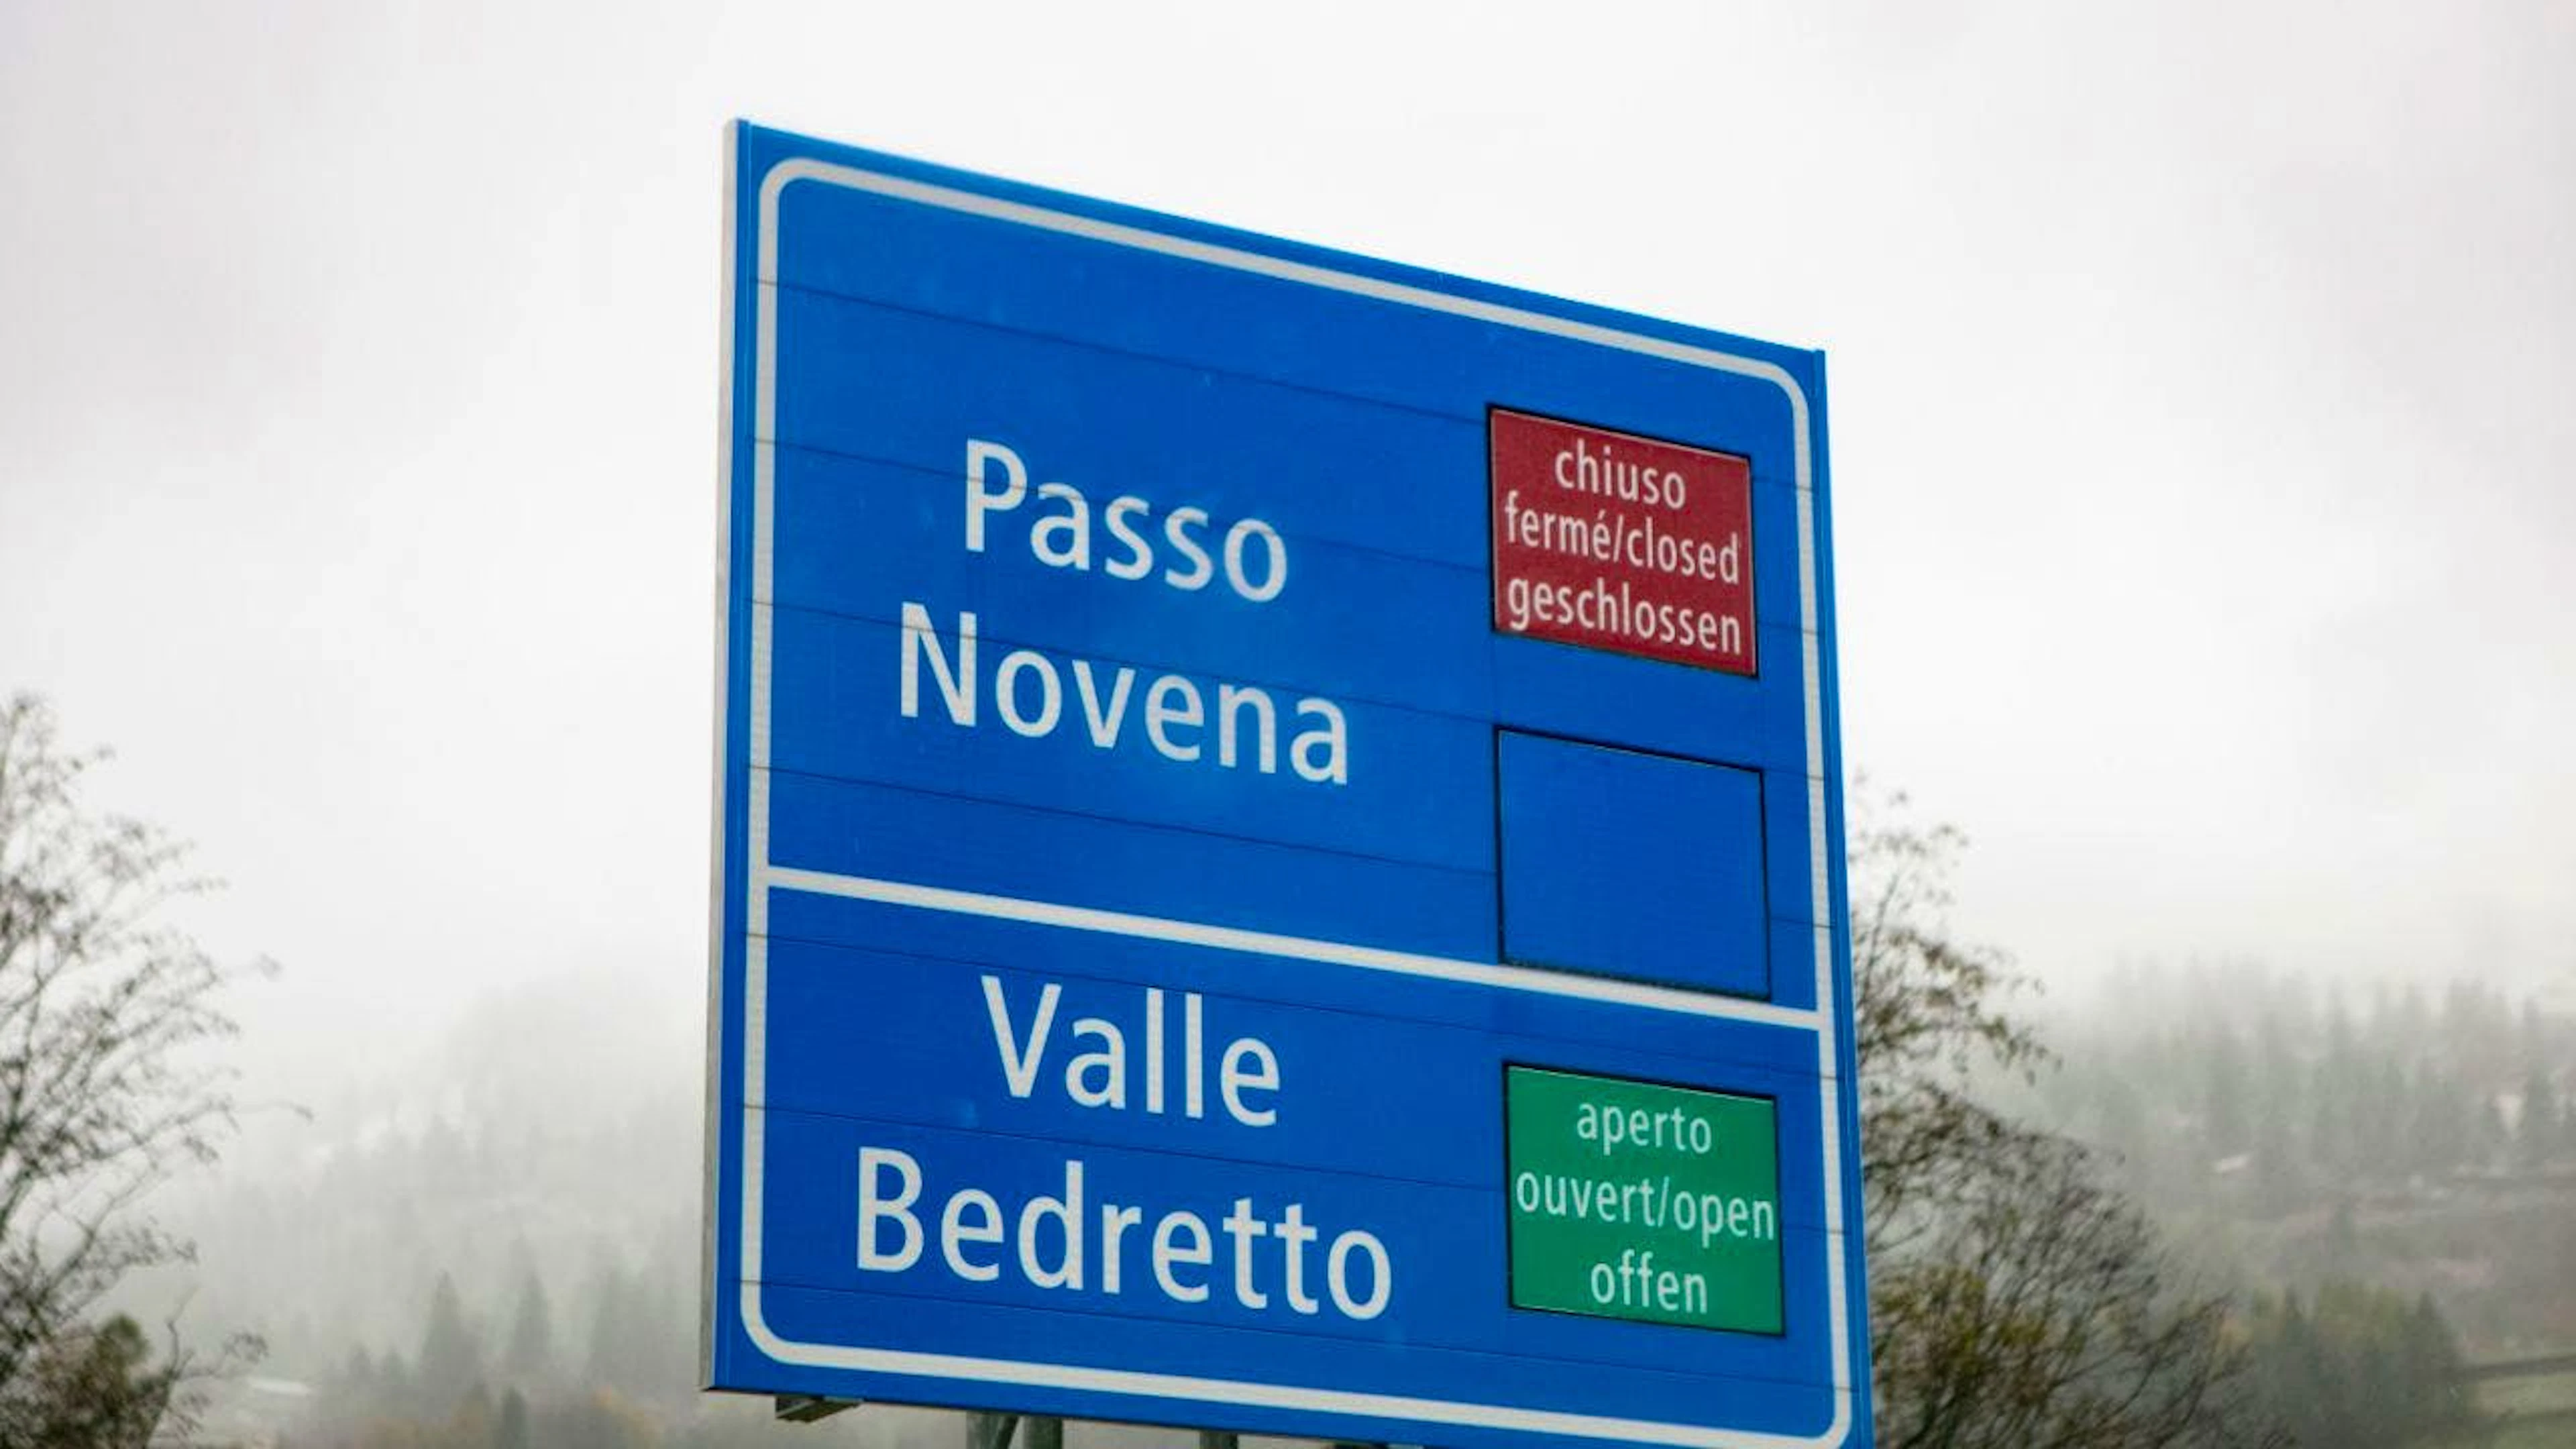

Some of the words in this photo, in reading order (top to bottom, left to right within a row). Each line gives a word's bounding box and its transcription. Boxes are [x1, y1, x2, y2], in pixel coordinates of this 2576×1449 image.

[1554, 438, 1686, 509] chiuso
[965, 439, 1287, 601] Passo
[1505, 490, 1739, 585] fermé/closed
[1507, 577, 1741, 655] geschlossen
[900, 602, 1348, 785] Novena
[981, 975, 1279, 1127] Valle
[1576, 1102, 1712, 1155] aperto
[857, 1146, 1391, 1320] Bedretto
[1515, 1171, 1775, 1248] ouvert/open
[1591, 1248, 1708, 1314] offen
